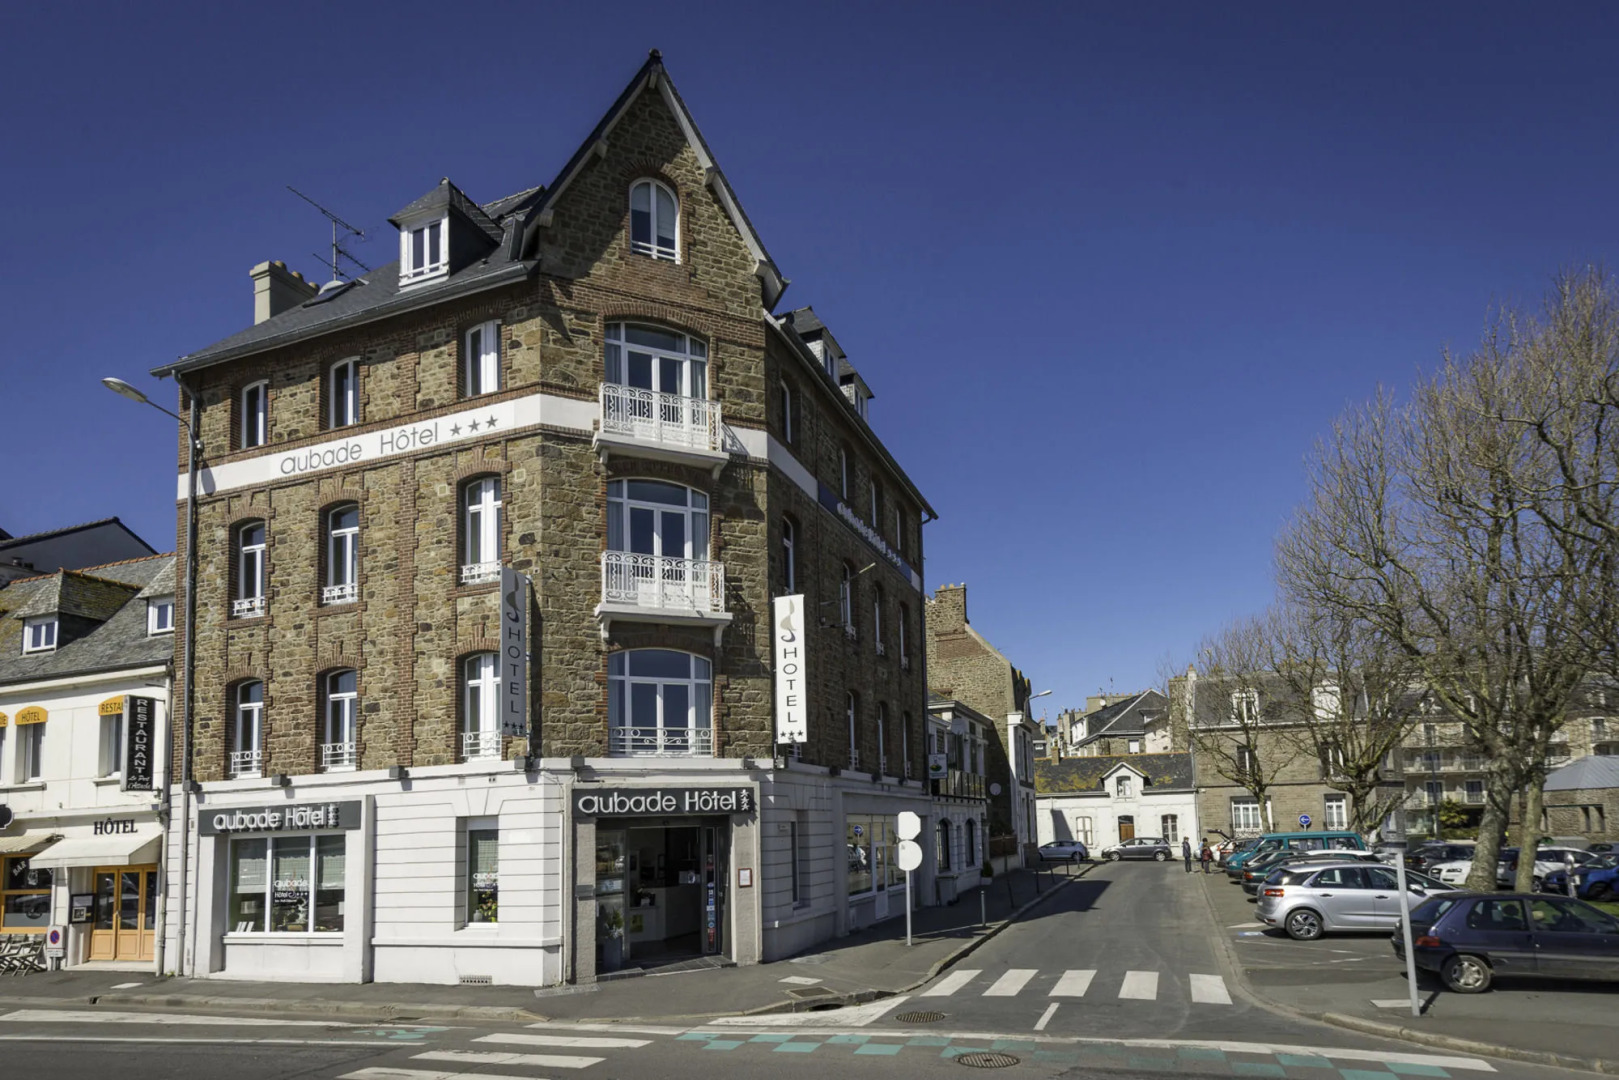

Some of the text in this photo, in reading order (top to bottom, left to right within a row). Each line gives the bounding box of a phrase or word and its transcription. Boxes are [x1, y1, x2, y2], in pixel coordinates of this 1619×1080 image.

[280, 422, 439, 475] aubade Hôtel
[507, 626, 521, 714] HOTEL
[783, 646, 798, 723] HOTEL
[134, 698, 148, 774] RESTAURANT
[93, 817, 138, 836] HÔTEL
[213, 805, 325, 830] aubade Hôtel
[578, 790, 737, 814] aubade Hôtel
